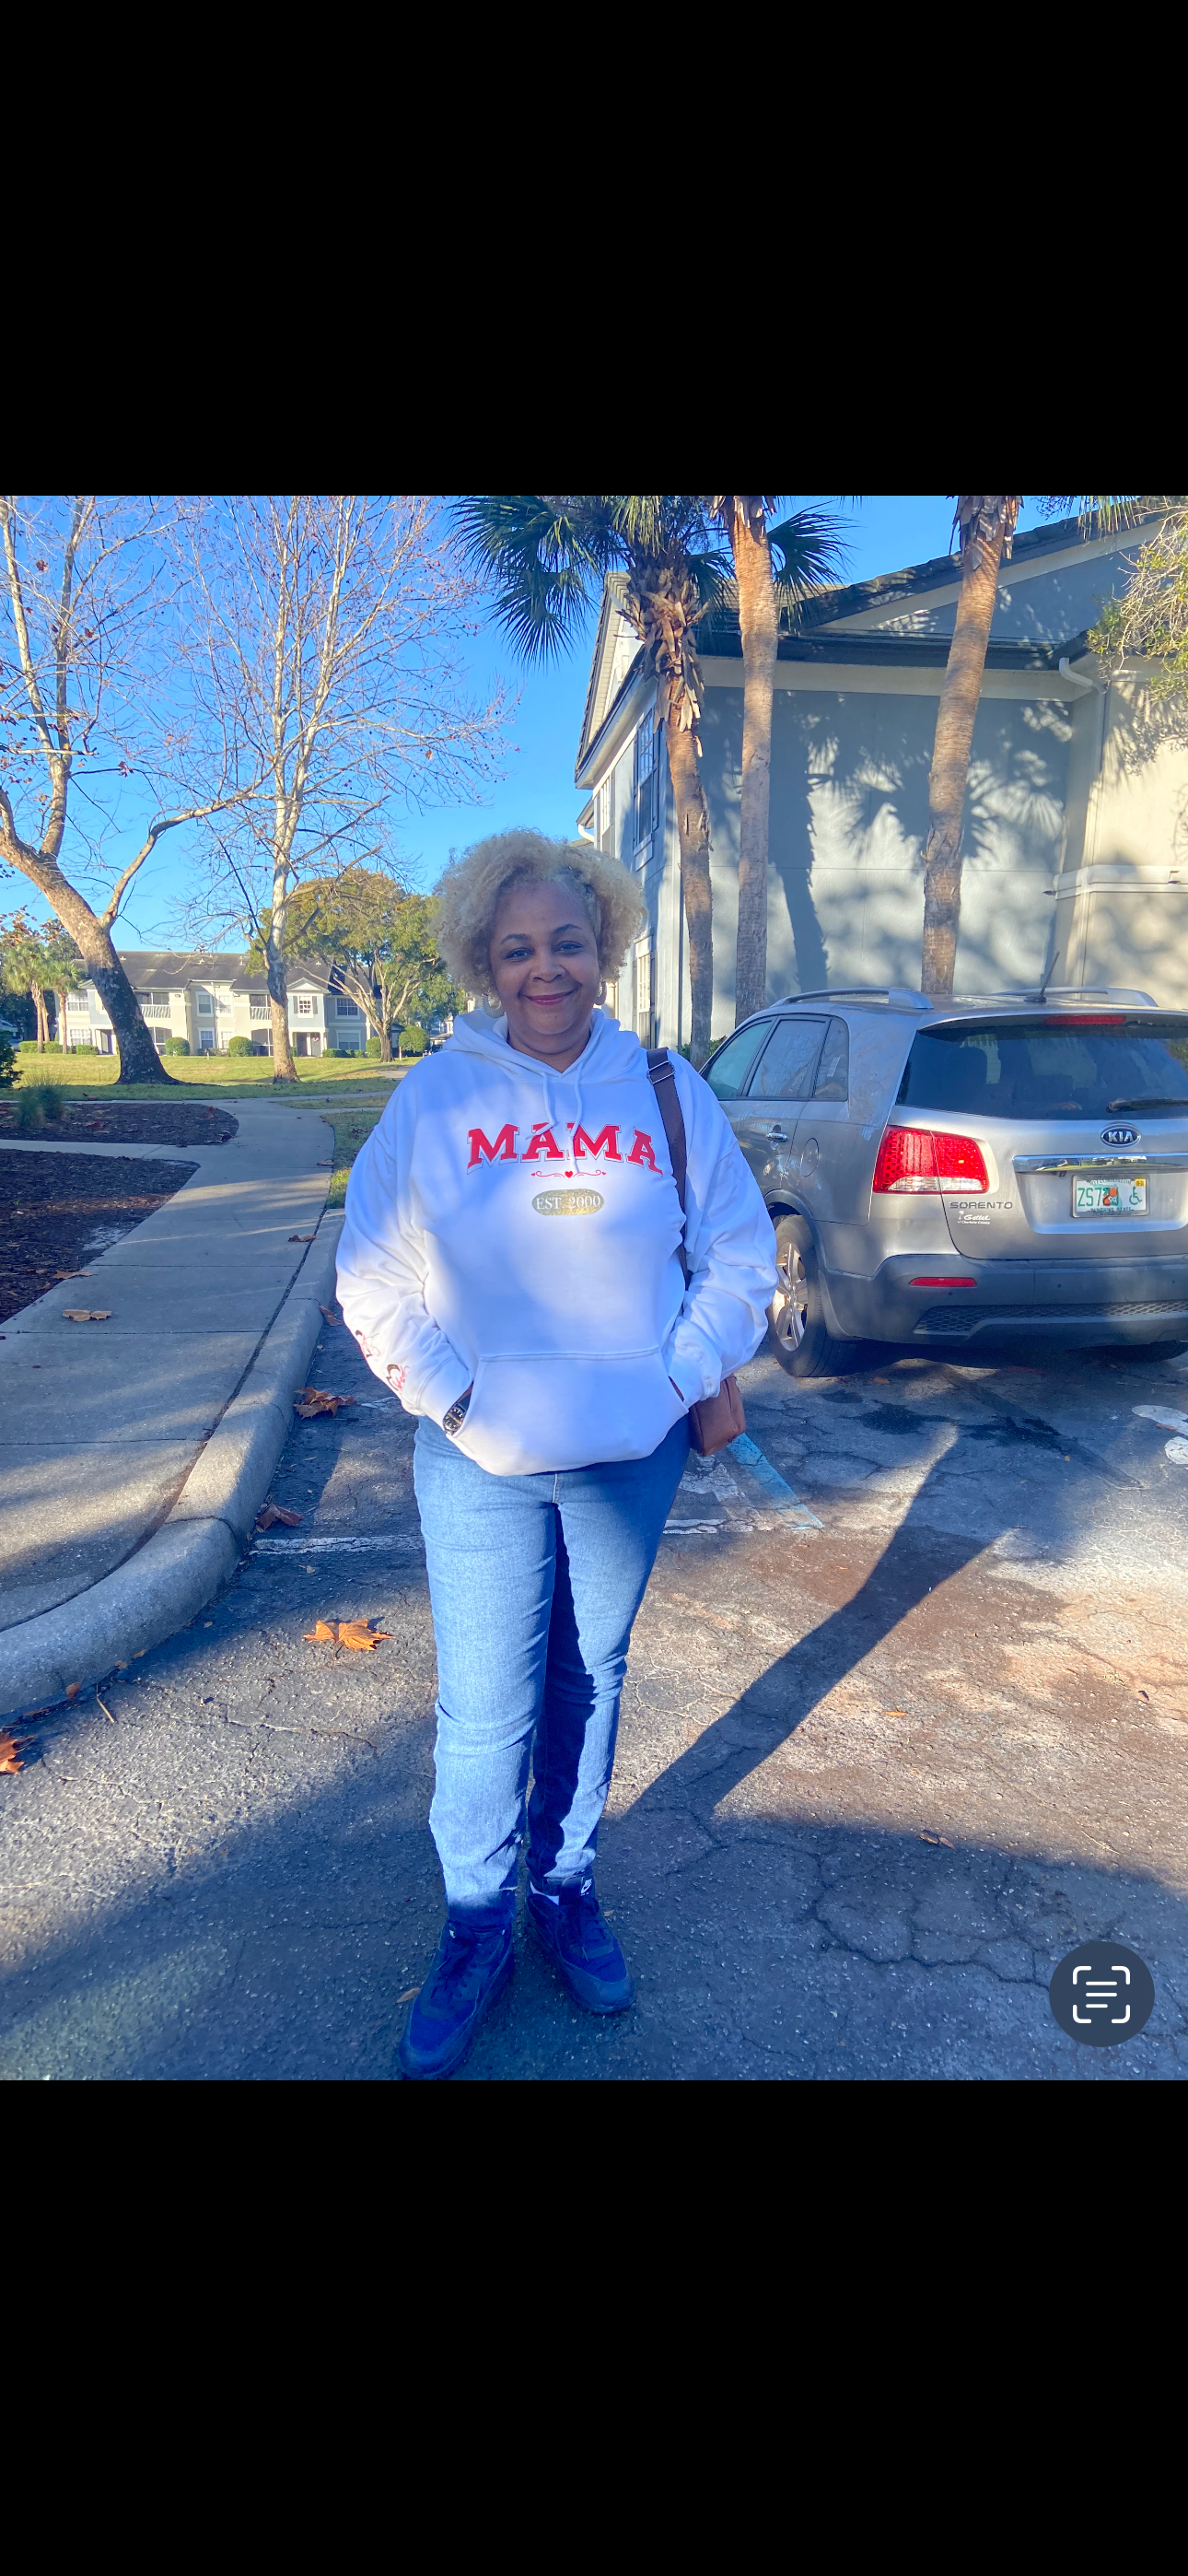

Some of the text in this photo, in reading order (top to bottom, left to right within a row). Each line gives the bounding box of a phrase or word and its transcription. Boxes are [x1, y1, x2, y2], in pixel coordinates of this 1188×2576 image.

[1108, 1130, 1134, 1142] KIA
[467, 1121, 664, 1176] MAMA
[536, 1195, 601, 1210] EST. 2000
